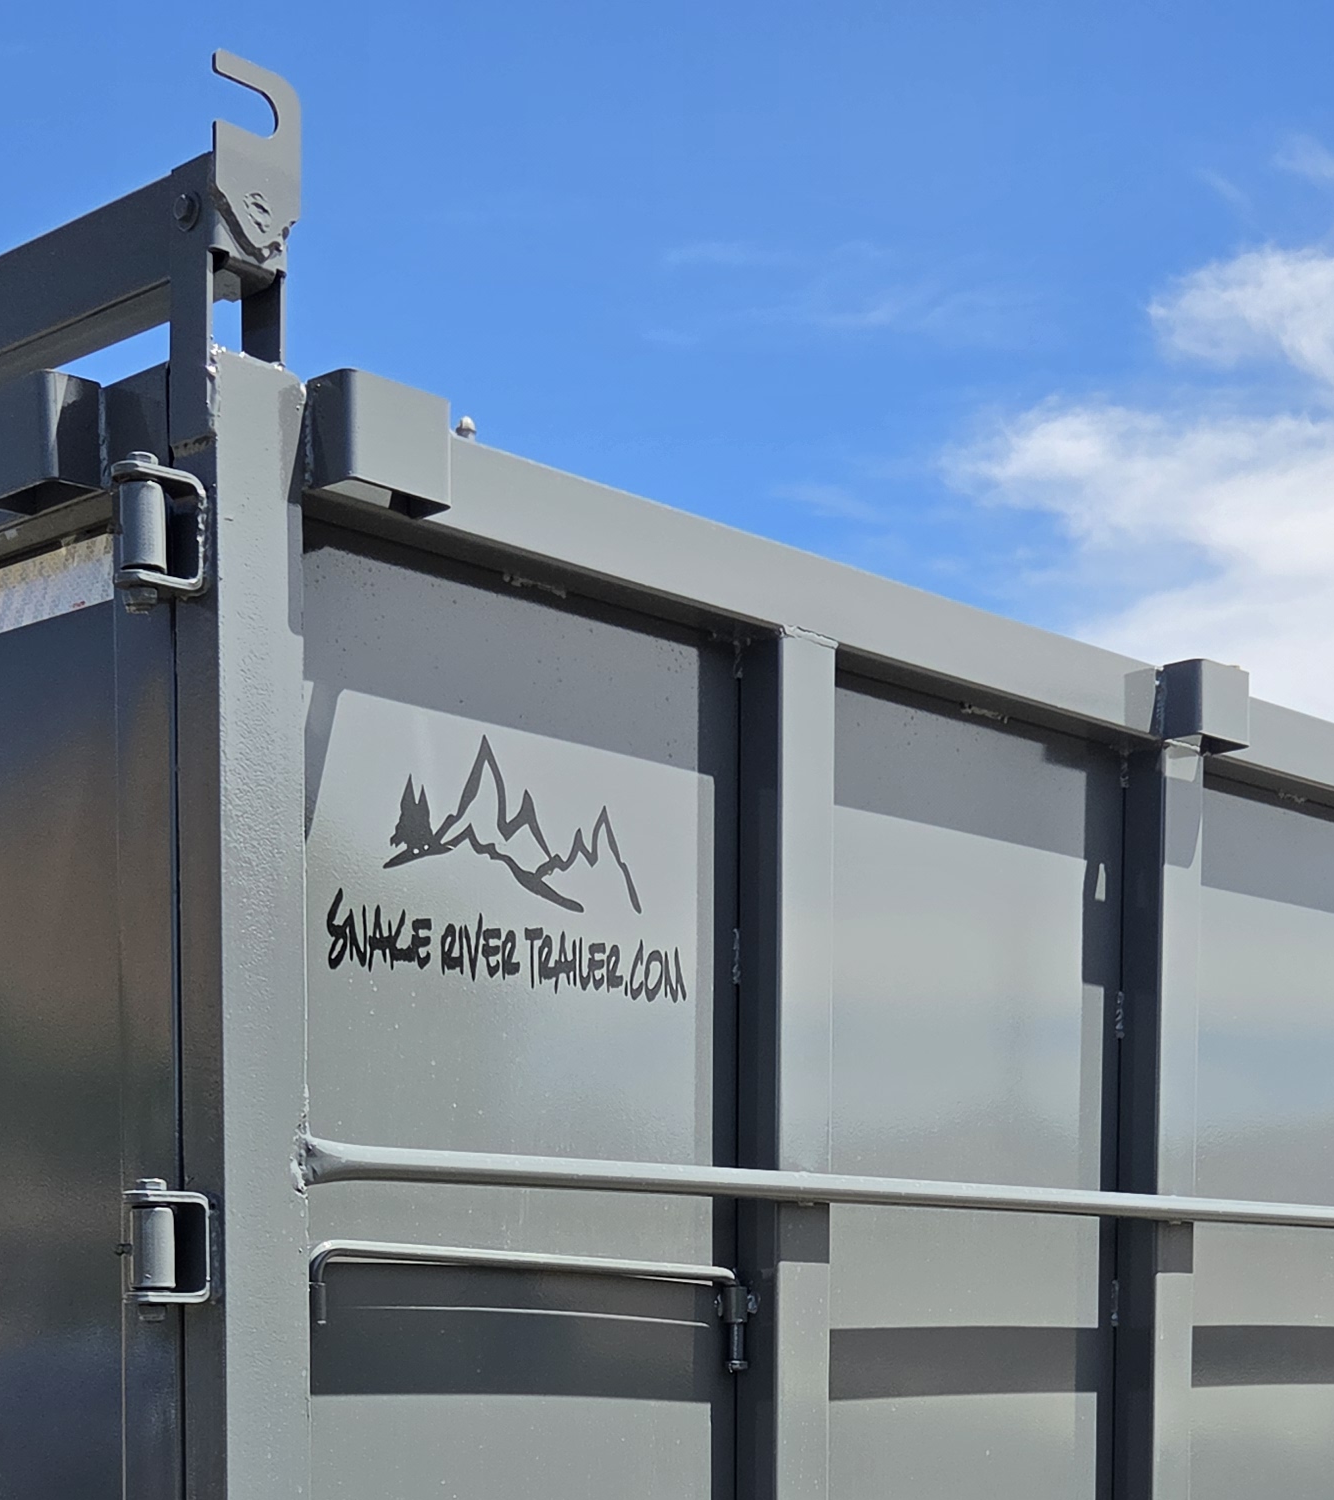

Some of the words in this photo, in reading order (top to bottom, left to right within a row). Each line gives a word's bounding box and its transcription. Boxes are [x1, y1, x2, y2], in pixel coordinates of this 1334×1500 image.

[327, 887, 432, 972] SNAKE
[440, 913, 521, 982] RIVER
[525, 927, 688, 1004] TRAILER.COM
